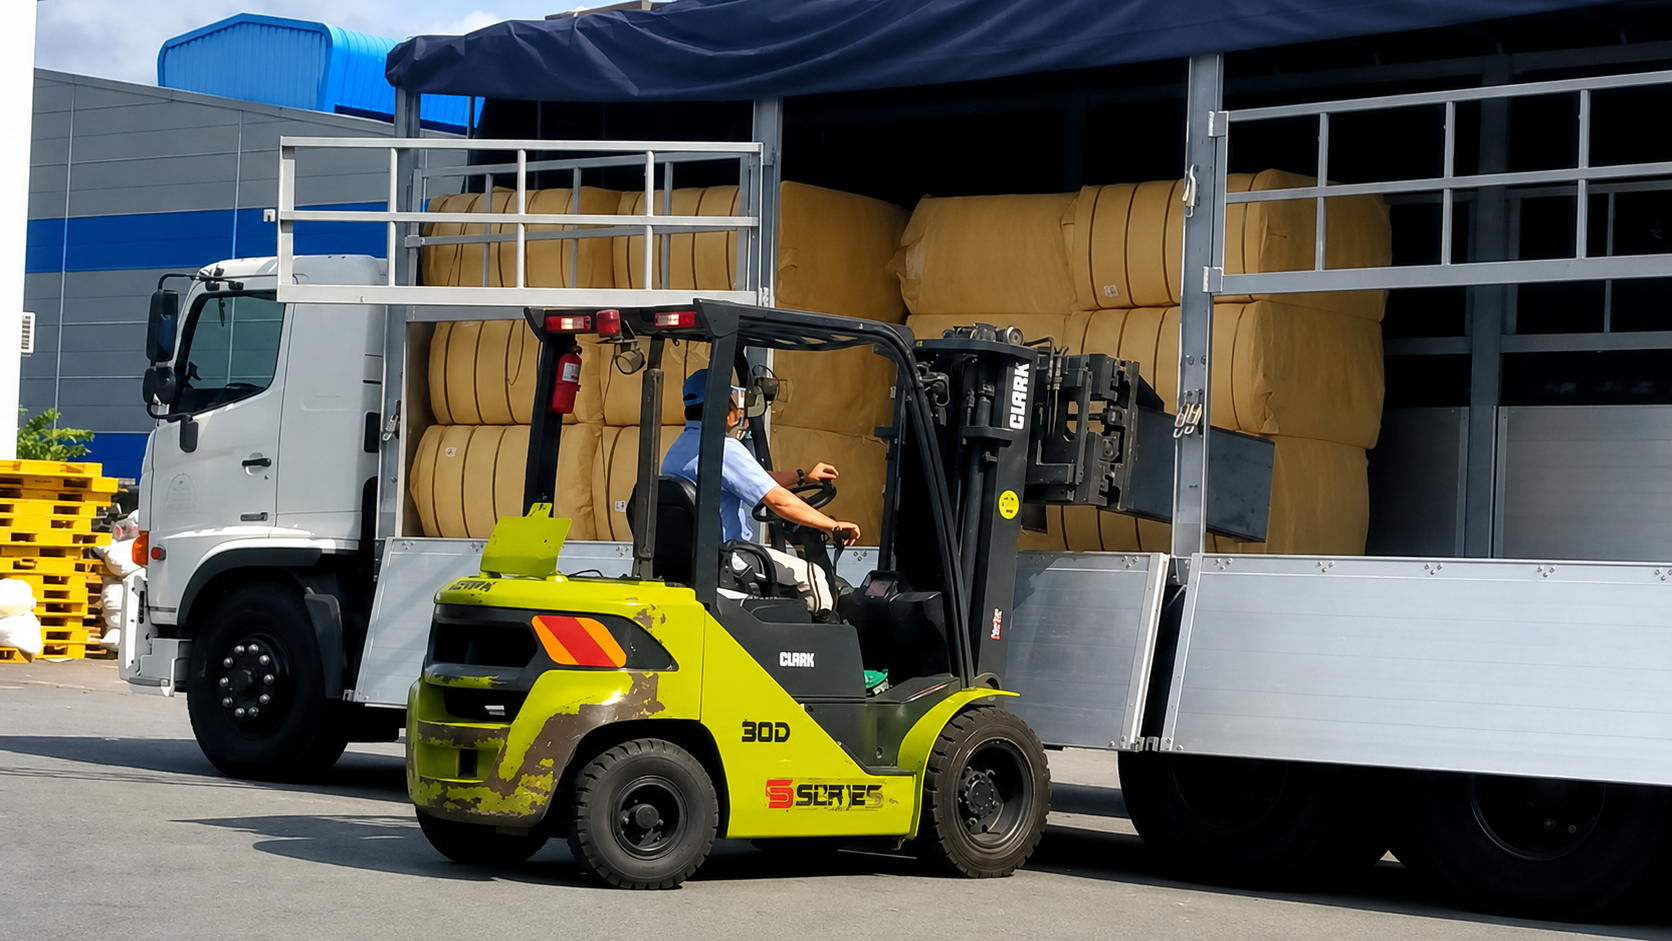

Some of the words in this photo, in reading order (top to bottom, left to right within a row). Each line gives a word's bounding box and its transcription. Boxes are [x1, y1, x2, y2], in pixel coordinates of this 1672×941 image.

[1009, 362, 1030, 430] CLARK
[779, 651, 815, 668] CLARK
[741, 721, 791, 743] 30D
